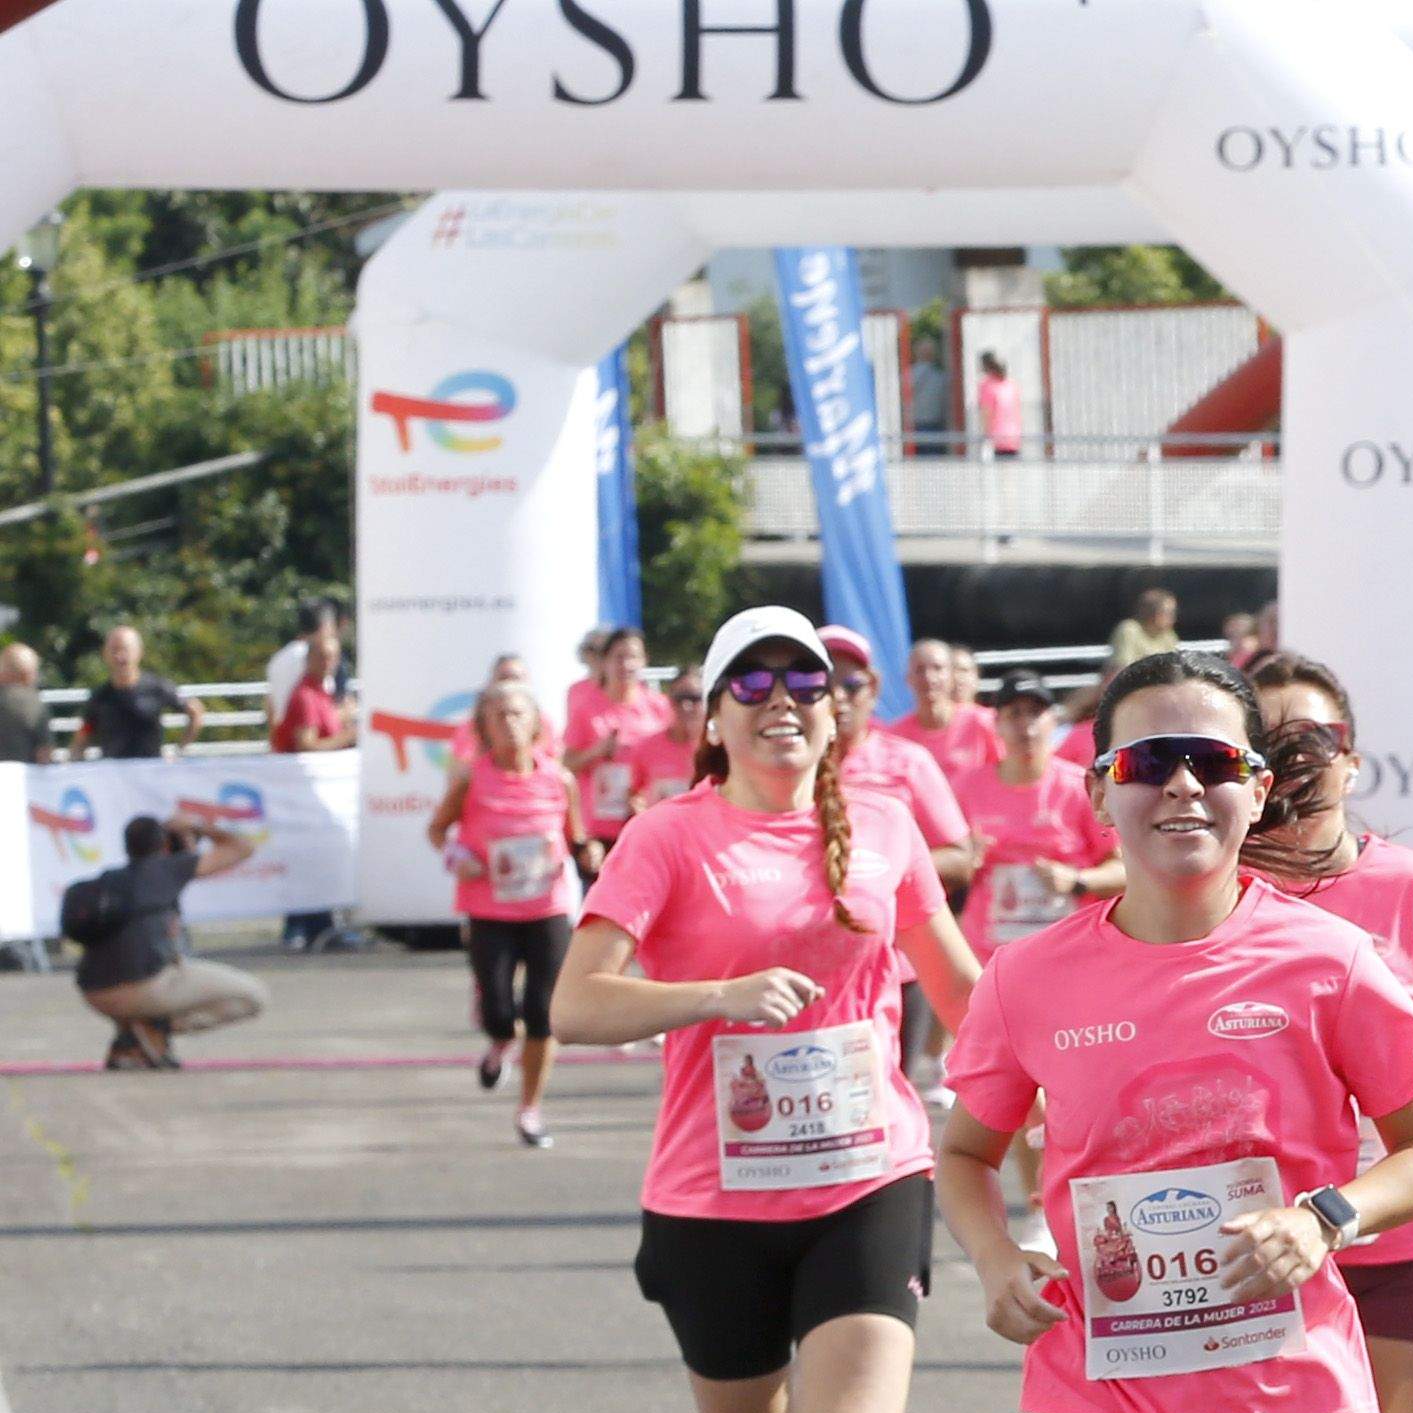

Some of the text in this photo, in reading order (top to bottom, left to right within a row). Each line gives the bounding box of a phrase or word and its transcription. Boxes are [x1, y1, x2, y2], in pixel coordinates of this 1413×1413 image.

[233, 0, 994, 104] OYSHO
[1054, 1021, 1136, 1050] OYSHO
[778, 1092, 832, 1116] 016
[1227, 1184, 1265, 1201] SUMA
[1137, 1206, 1215, 1226] ASTURIANA
[1147, 1248, 1218, 1280] 016
[1162, 1287, 1208, 1307] 3792
[1110, 1316, 1162, 1332] CARRERA
[1164, 1316, 1181, 1328] DE
[1184, 1314, 1200, 1326] LA
[1203, 1307, 1245, 1322] MUJER
[1221, 1327, 1287, 1350] Santander
[1106, 1345, 1166, 1363] OYSHO
